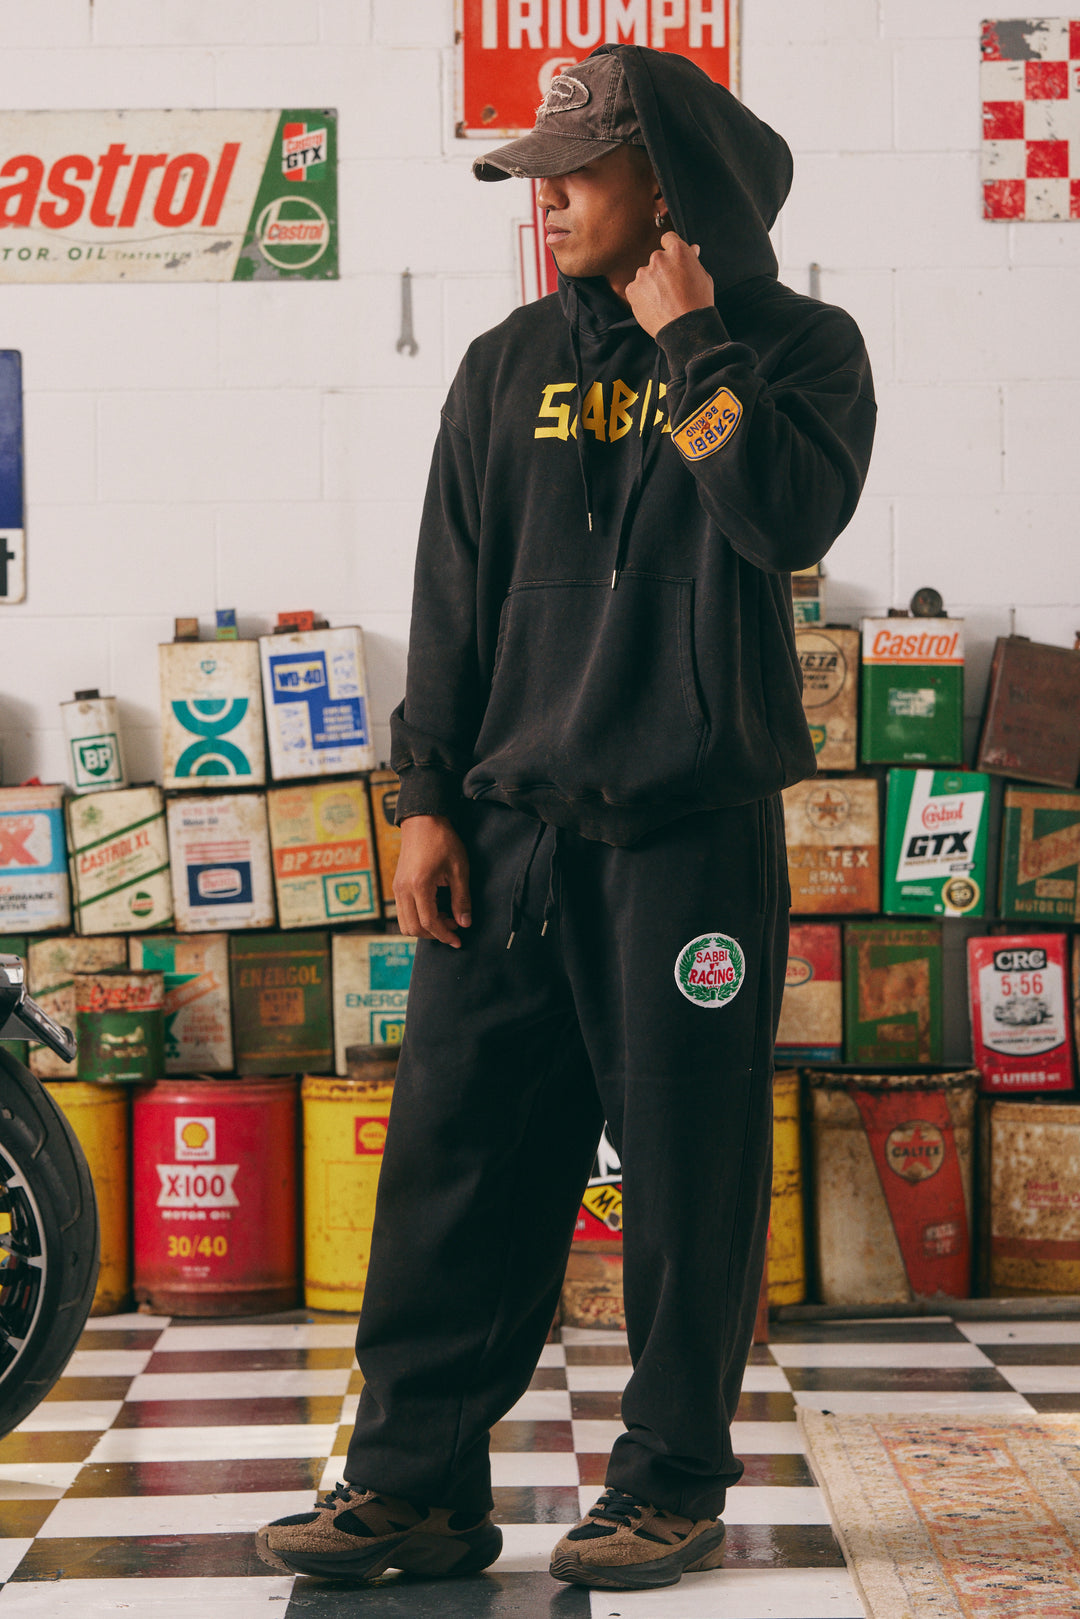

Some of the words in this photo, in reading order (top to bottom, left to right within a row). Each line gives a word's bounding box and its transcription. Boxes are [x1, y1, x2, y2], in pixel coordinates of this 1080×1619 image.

[481, 0, 726, 49] TRIUMPH
[287, 145, 322, 169] GTX
[267, 221, 325, 241] Castrol
[68, 246, 107, 260] OIL
[704, 405, 719, 420] BE
[686, 417, 706, 437] KIND
[688, 408, 736, 455] SABBI
[871, 629, 959, 657] Castrol
[278, 668, 322, 688] WD-40
[84, 746, 110, 770] BP
[921, 801, 965, 831] Castrol
[80, 838, 133, 874] CASTROL
[134, 829, 151, 850] XL
[906, 830, 972, 858] GTX
[282, 853, 309, 872] BP
[309, 844, 363, 870] ZOOM
[788, 850, 870, 868] CALTEX
[338, 884, 360, 902] BP
[696, 949, 728, 963] SABBI
[995, 949, 1045, 970] CRC
[239, 965, 321, 987] ENERGOL
[688, 966, 734, 985] RACING
[1002, 1071, 1046, 1084] LITRES
[891, 1146, 940, 1158] CALTEX
[161, 1210, 207, 1221] MOTOR
[209, 1210, 232, 1221] OIL
[167, 1235, 228, 1259] 30/40
